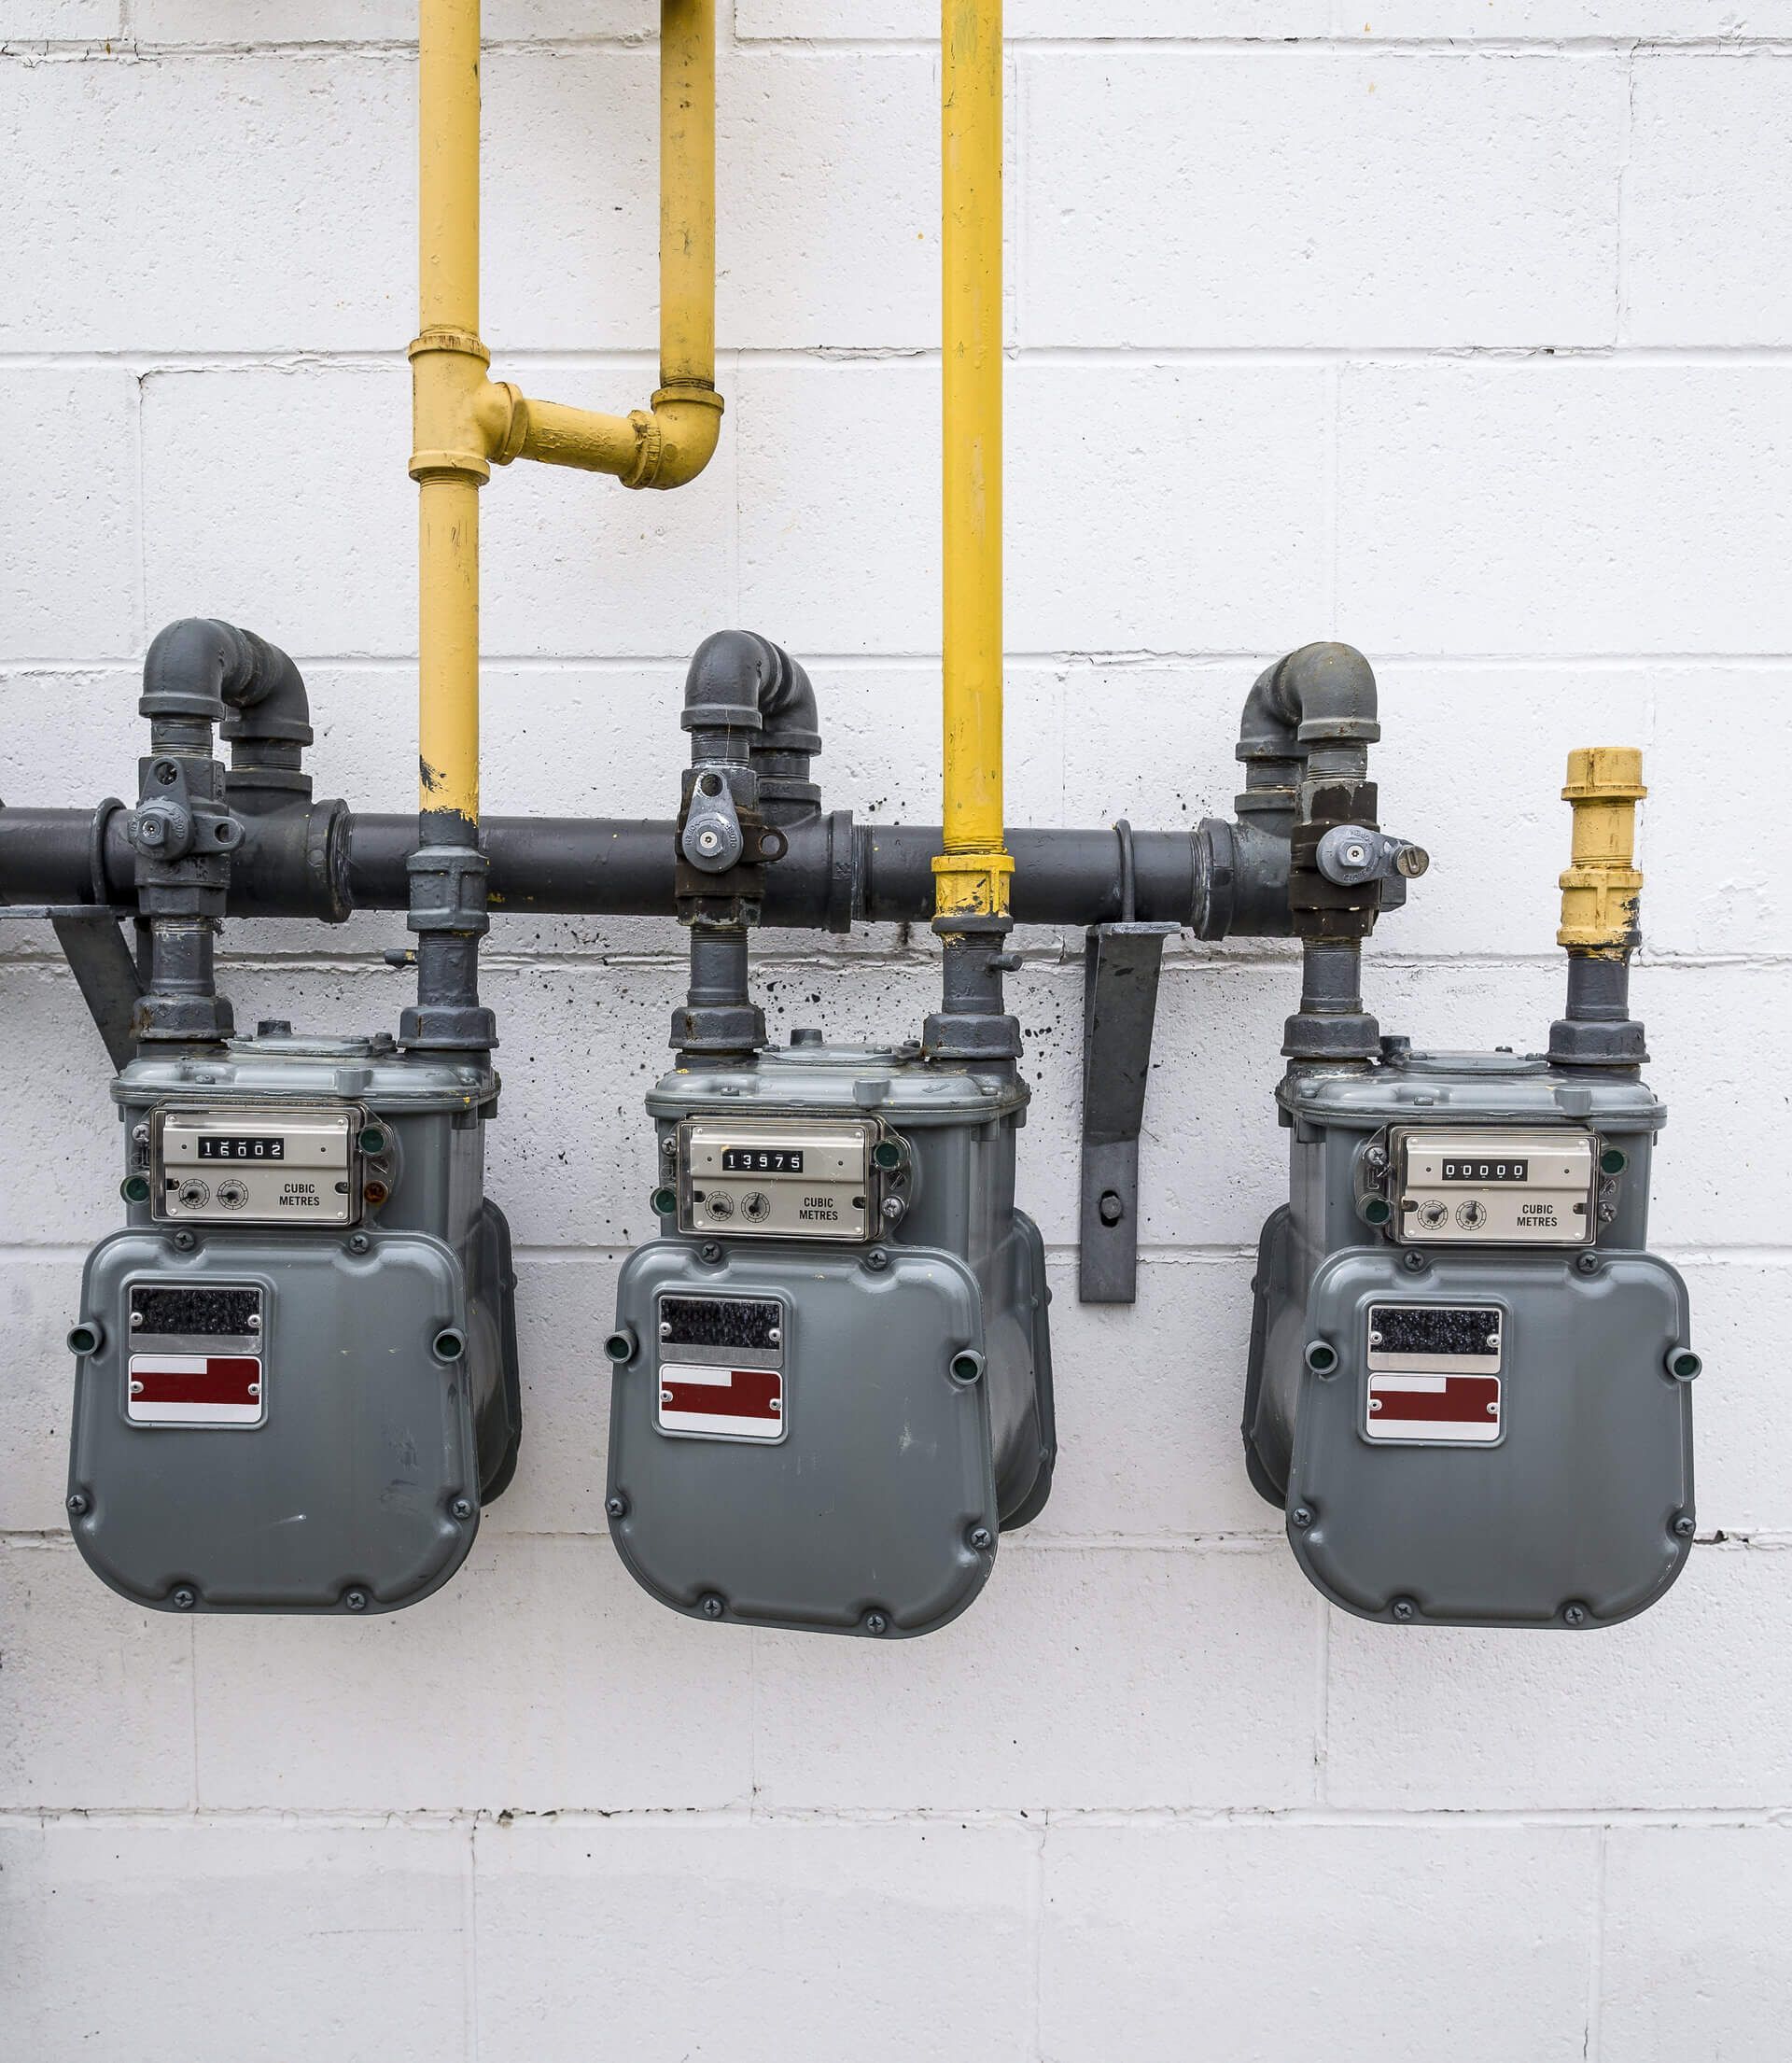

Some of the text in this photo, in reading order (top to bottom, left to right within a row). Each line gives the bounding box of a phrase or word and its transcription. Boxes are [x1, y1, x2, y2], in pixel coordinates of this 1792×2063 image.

[204, 1142, 281, 1157] 16002
[729, 1154, 800, 1169] 13975
[1446, 1164, 1523, 1176] 00000
[284, 1183, 315, 1194] CUBIC
[279, 1195, 320, 1207] METRES
[804, 1197, 834, 1209] CUBIC
[799, 1209, 839, 1221] METRES
[1522, 1204, 1554, 1214] CUBIC
[1516, 1216, 1558, 1228] METRES
